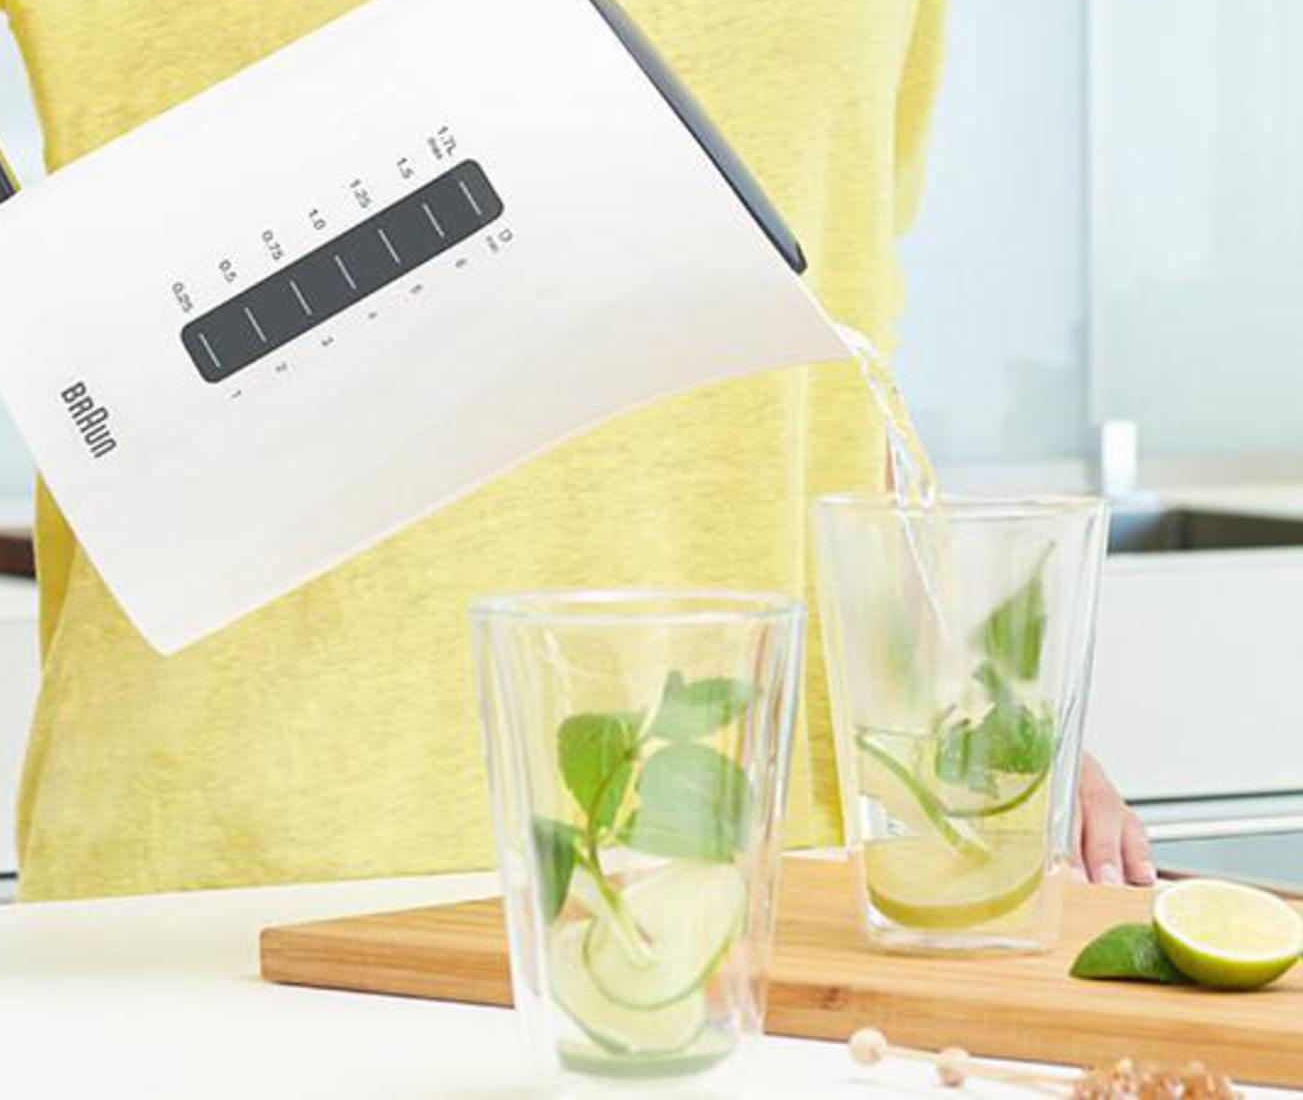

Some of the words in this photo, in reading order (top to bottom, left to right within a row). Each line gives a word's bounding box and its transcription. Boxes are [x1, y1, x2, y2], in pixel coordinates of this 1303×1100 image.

[397, 157, 414, 180] 1.5
[349, 178, 372, 209] 1.25
[308, 208, 327, 231] 1.0
[261, 229, 285, 262] 0.75
[218, 259, 238, 284] 0.5
[172, 282, 194, 314] 0.25
[61, 380, 117, 459] BRAUN
